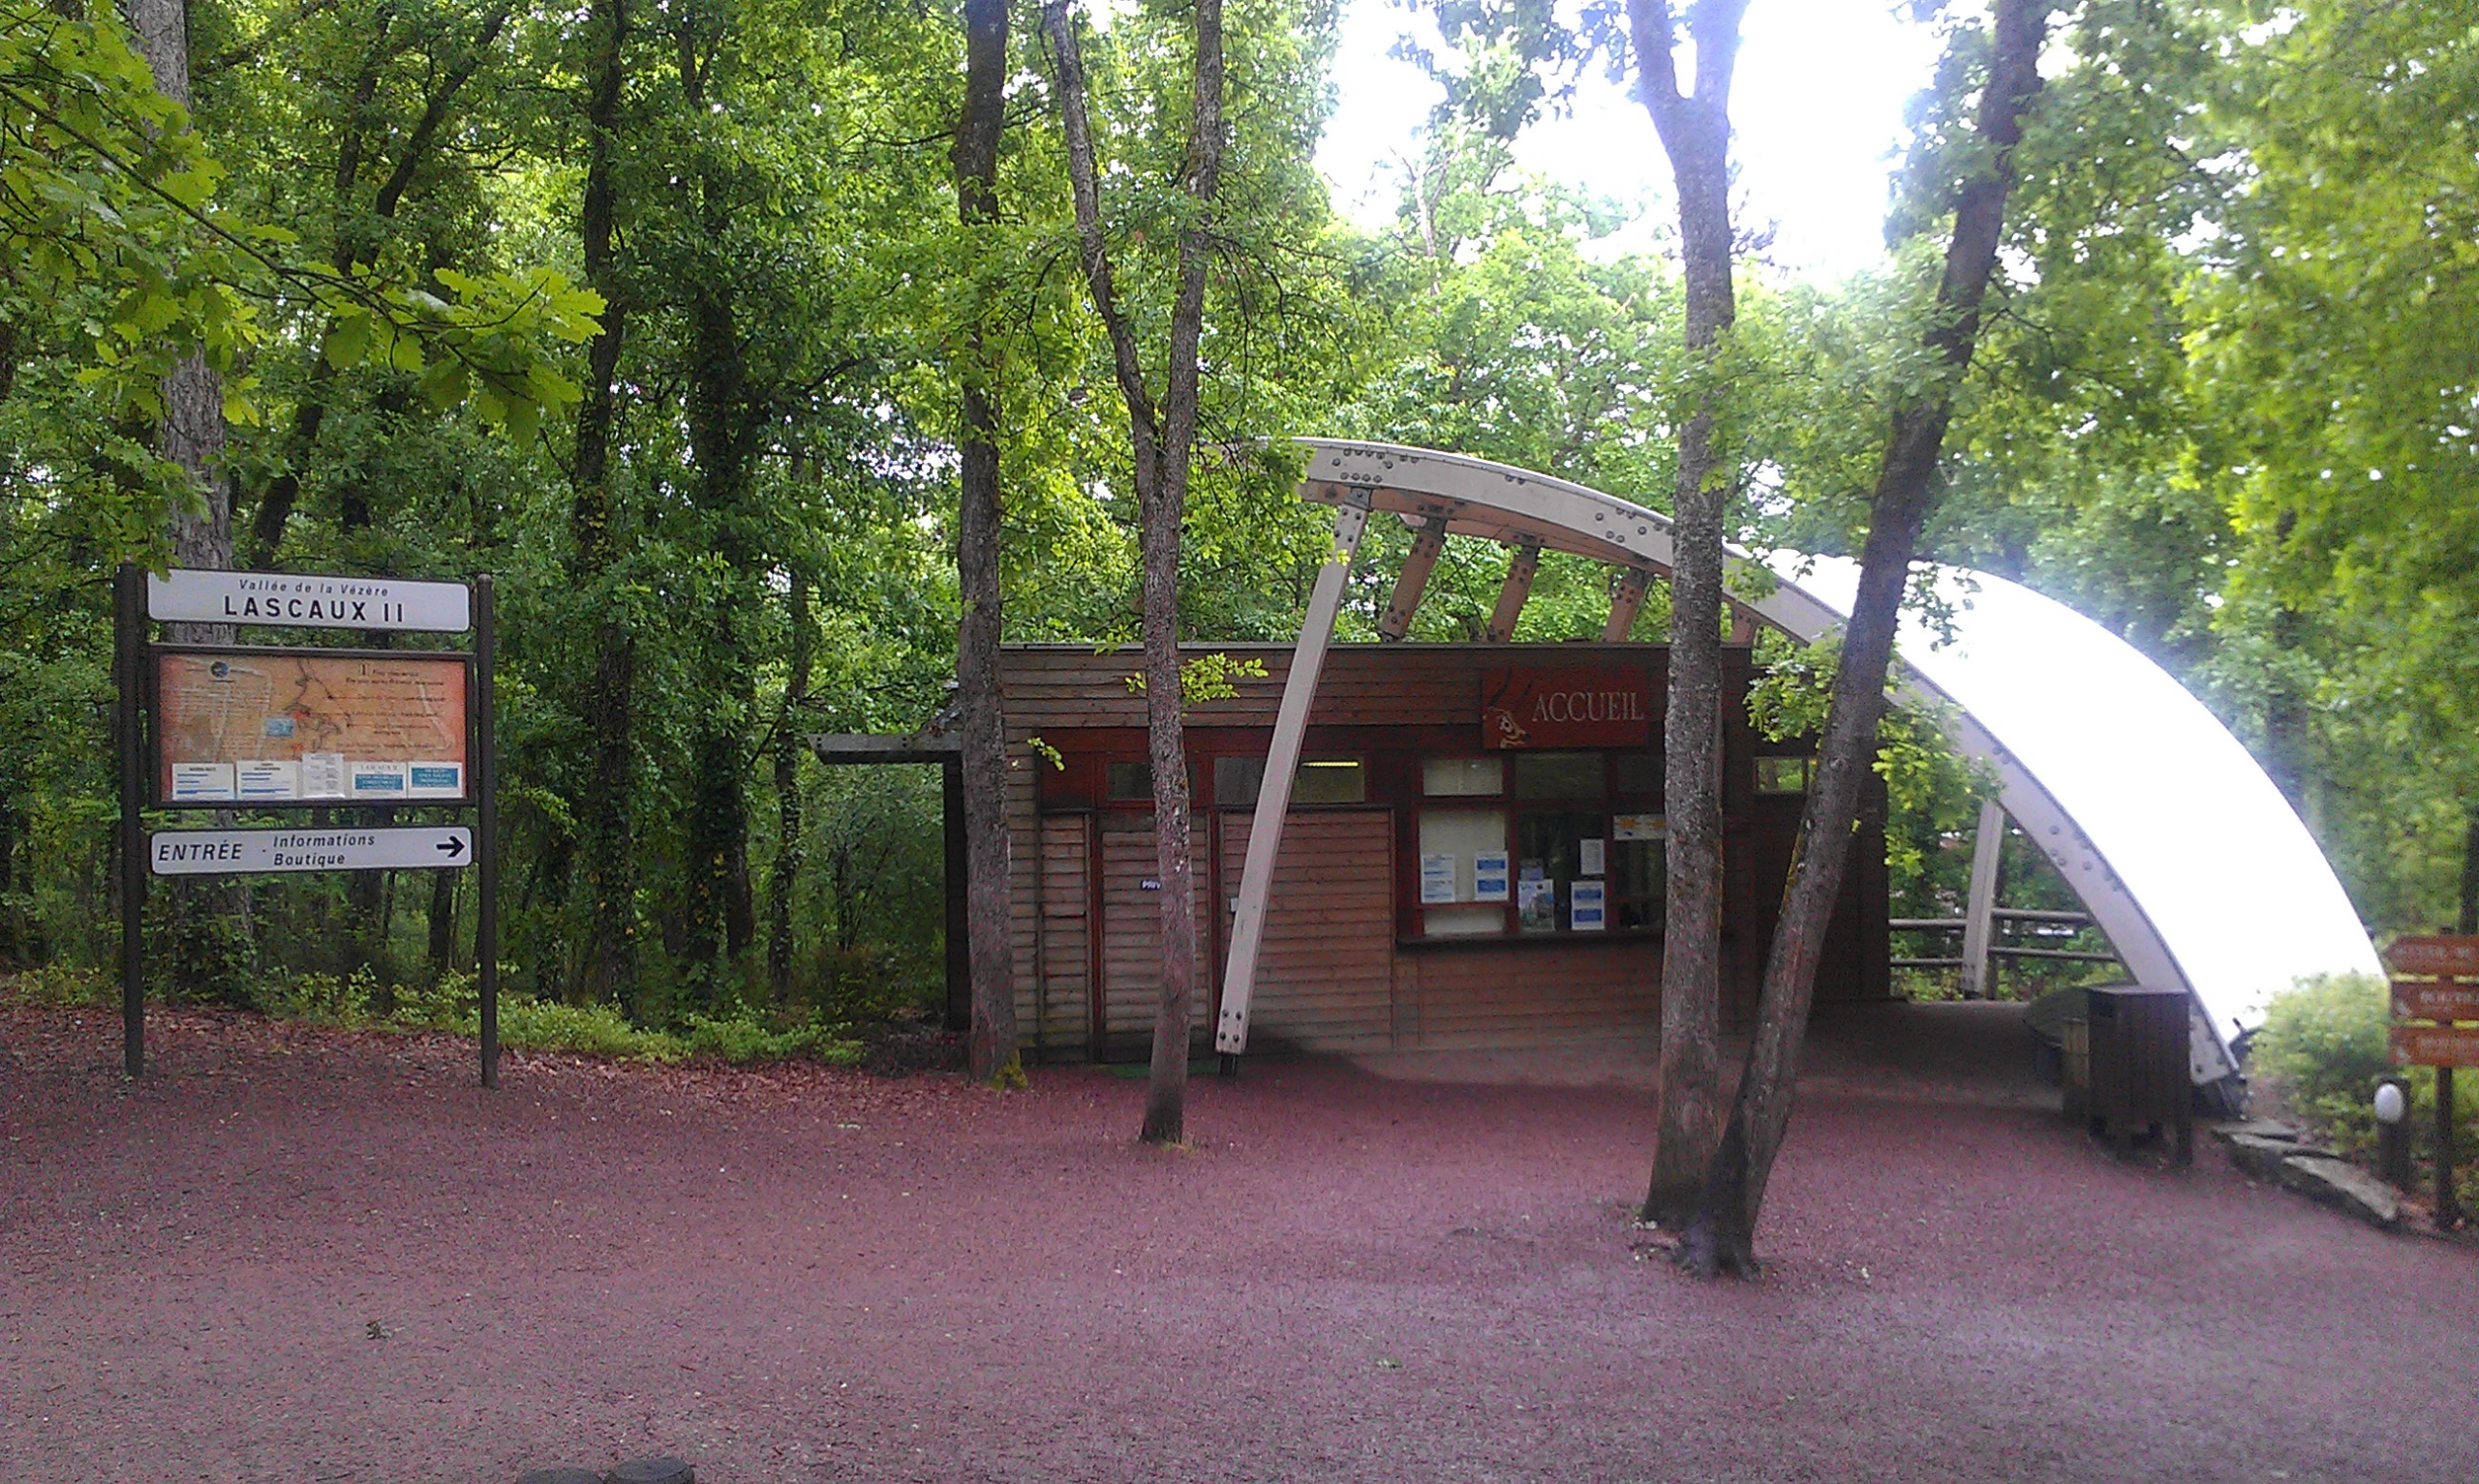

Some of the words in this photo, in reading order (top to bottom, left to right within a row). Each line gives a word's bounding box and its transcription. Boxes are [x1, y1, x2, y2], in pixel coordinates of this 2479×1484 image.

[239, 578, 288, 592] Vallée
[295, 580, 313, 593] de
[320, 582, 333, 594] la
[340, 583, 389, 597] Vézère
[225, 594, 367, 622] LASCAUX
[383, 602, 404, 622] II
[1531, 691, 1645, 722] ACCUEIL
[158, 839, 243, 862] ENTRÉE
[273, 833, 376, 848] Informations
[274, 852, 346, 867] Boutique
